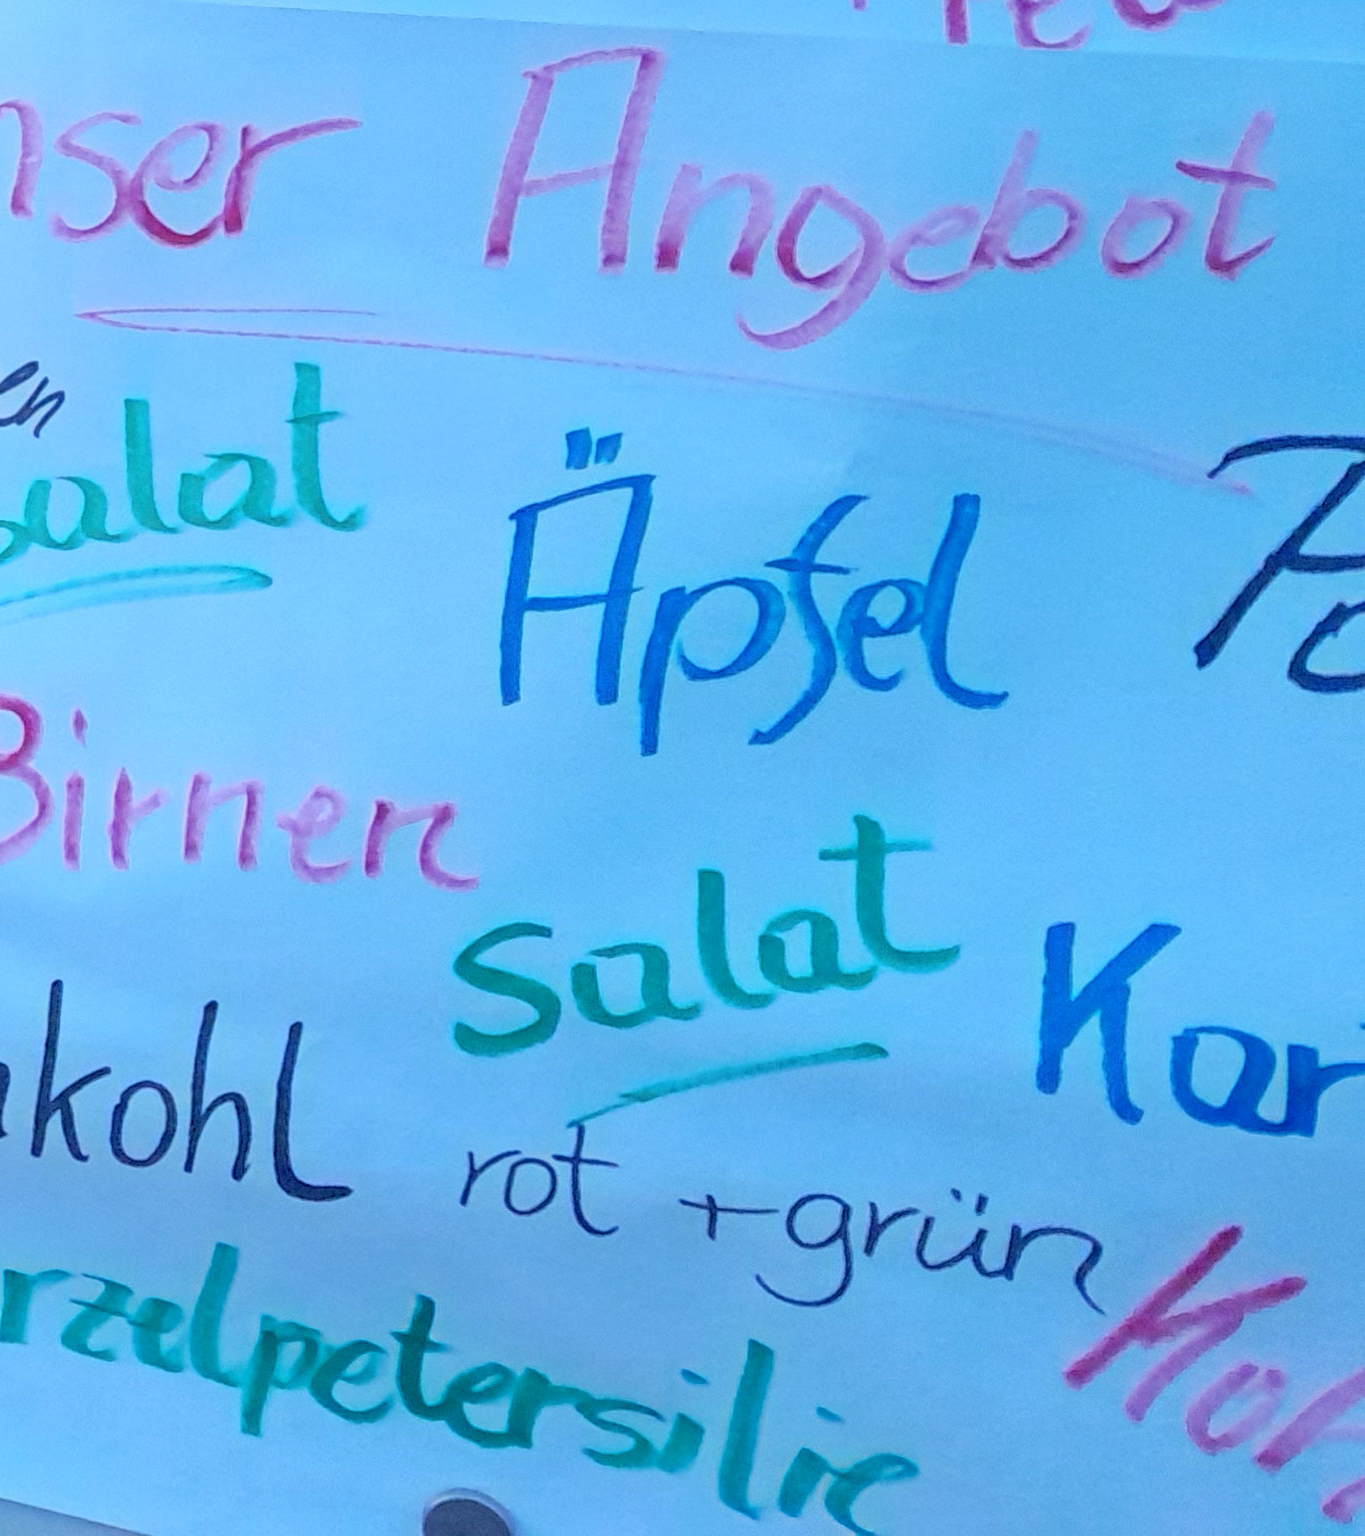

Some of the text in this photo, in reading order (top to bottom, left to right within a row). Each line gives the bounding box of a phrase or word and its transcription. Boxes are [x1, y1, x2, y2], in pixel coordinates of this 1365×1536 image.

[483, 46, 1277, 351] Angebot
[497, 427, 1011, 757] Äpfel
[459, 1119, 621, 1237] rot
